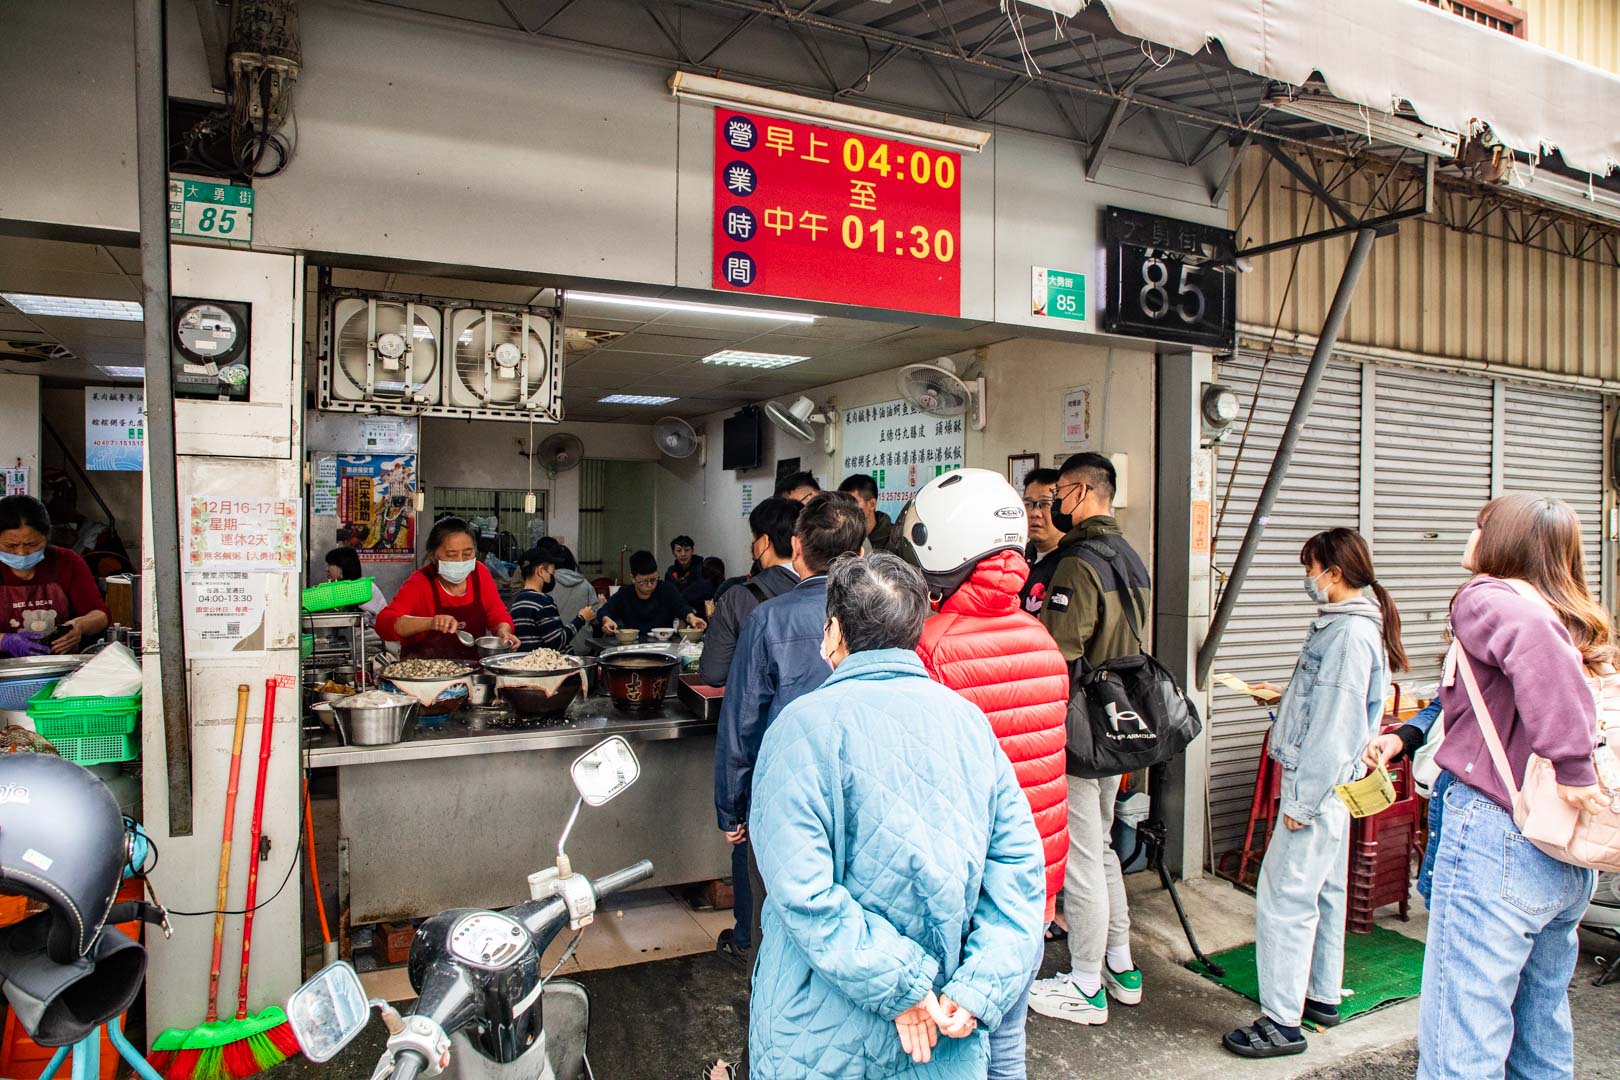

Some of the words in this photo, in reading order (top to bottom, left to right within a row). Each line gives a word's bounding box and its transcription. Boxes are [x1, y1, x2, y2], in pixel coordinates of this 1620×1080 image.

[765, 126, 830, 164] 早上
[842, 137, 955, 189] 04:00
[186, 184, 252, 205] 大勇街
[728, 121, 752, 284] 營業時間
[849, 179, 877, 211] 至
[198, 207, 237, 234] 85
[764, 206, 829, 242] 中午
[841, 214, 954, 263] 01:30
[1048, 275, 1073, 289] 大勇街
[1140, 256, 1206, 324] 85
[1056, 294, 1076, 312] 85
[202, 501, 285, 516] 12月16-17日
[209, 518, 281, 531] 星期一、二
[221, 534, 268, 546] 連休2天
[12, 601, 26, 609] BEE
[198, 594, 253, 603] 04:00-13:30
